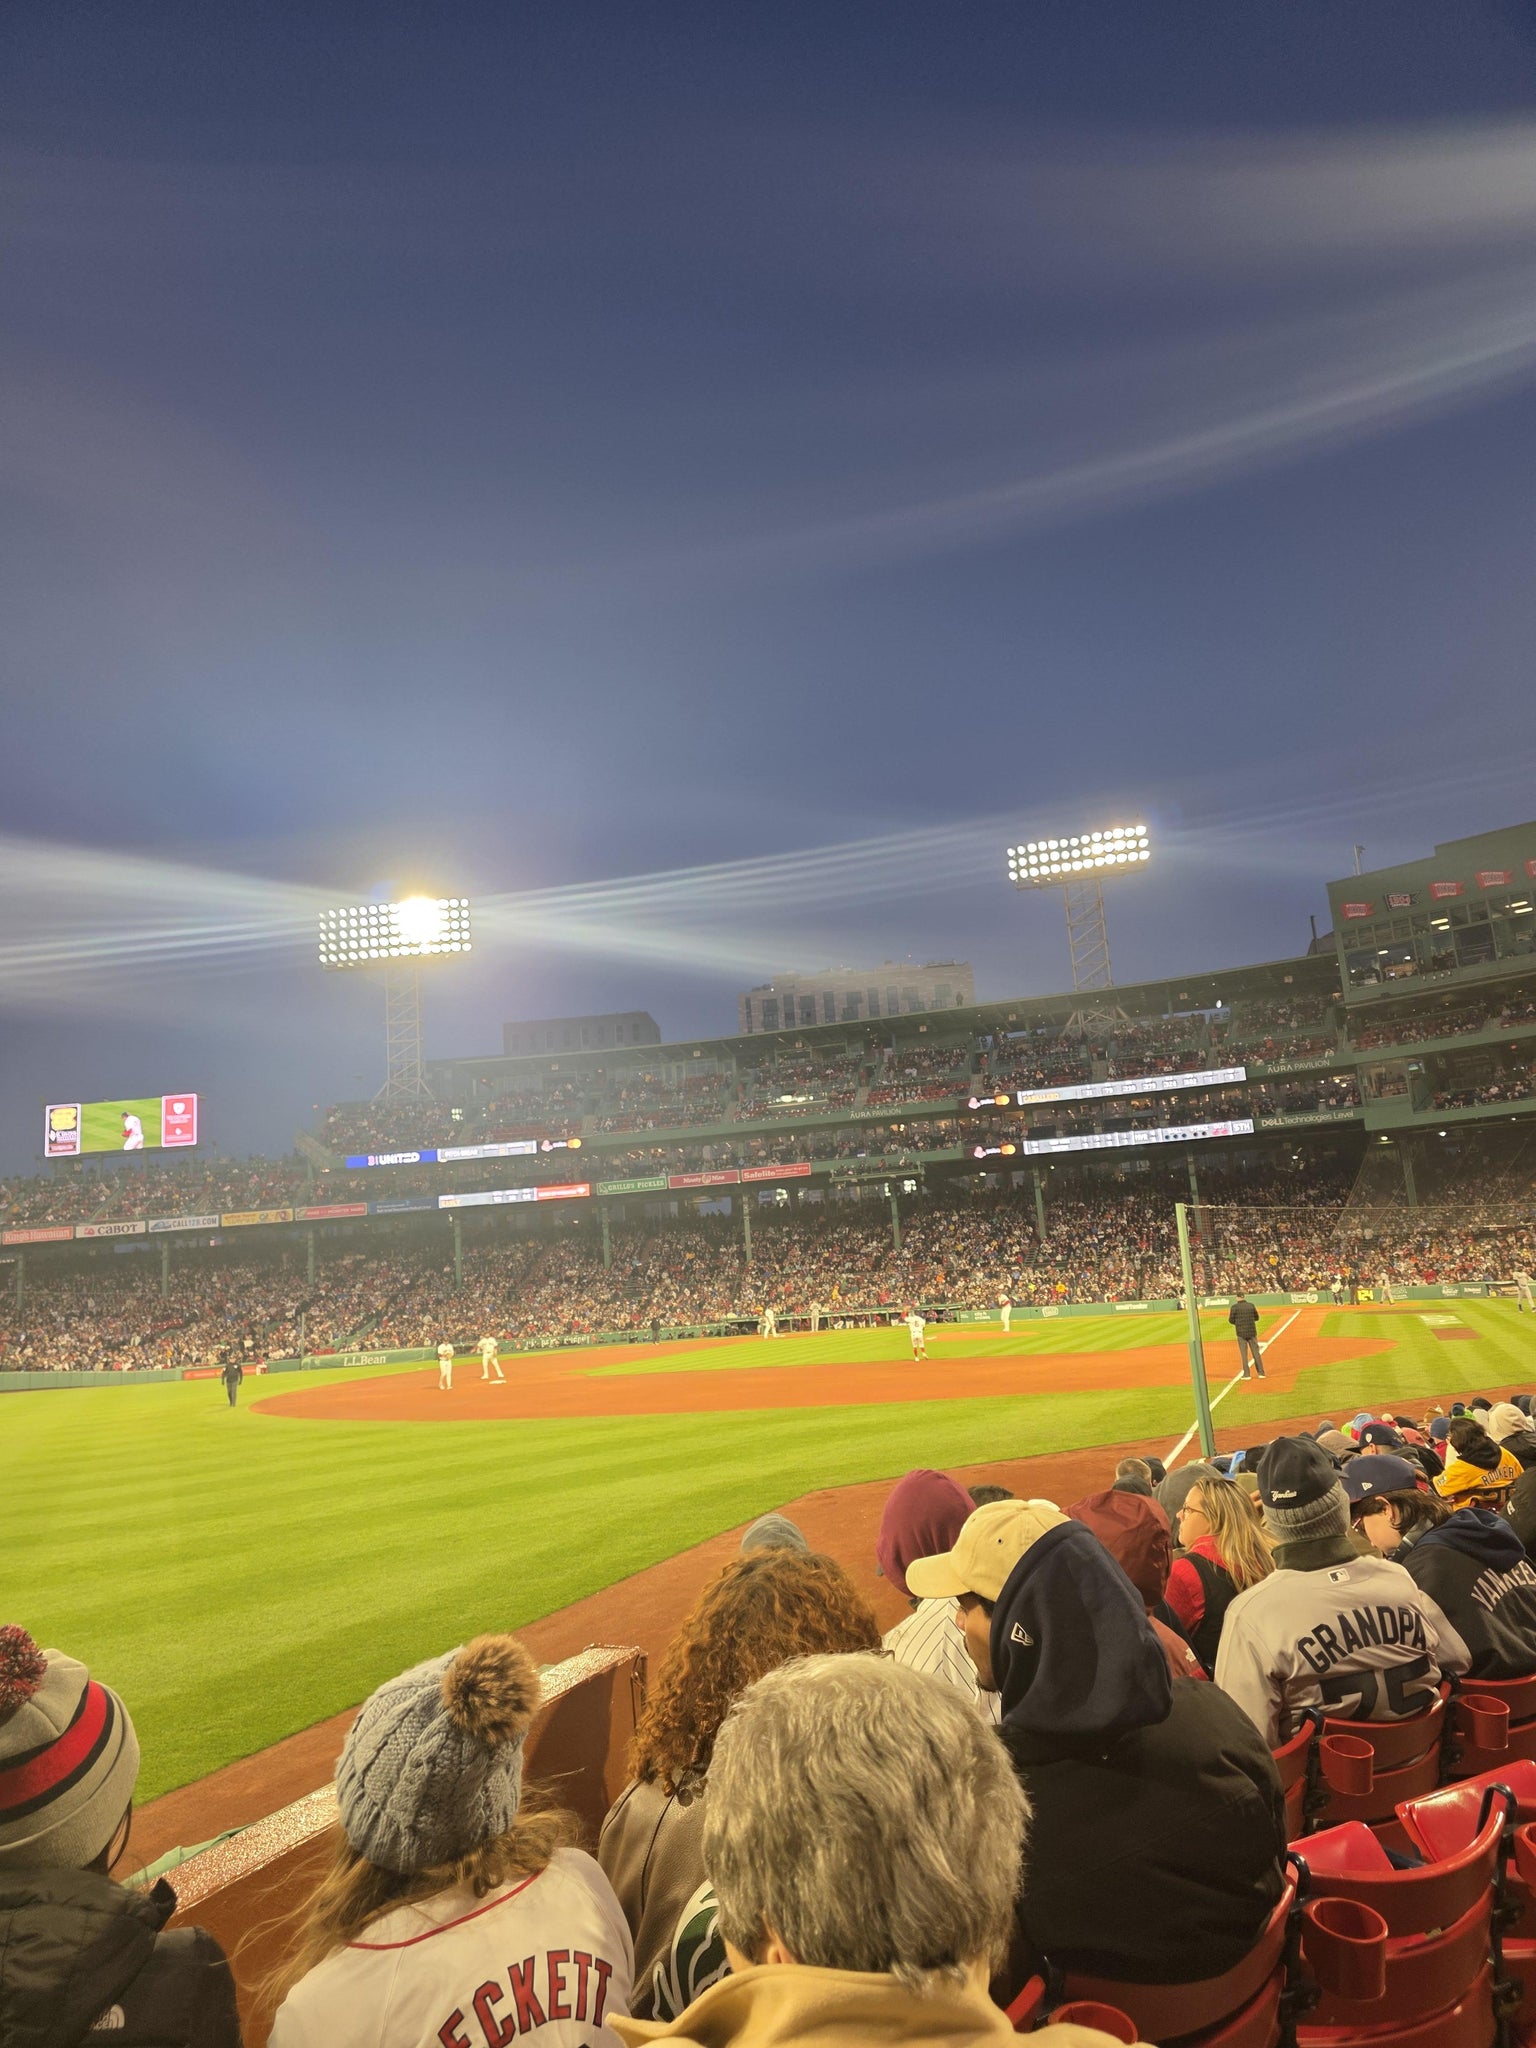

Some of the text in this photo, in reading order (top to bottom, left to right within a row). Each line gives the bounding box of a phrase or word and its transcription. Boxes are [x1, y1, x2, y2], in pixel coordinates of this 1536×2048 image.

[1294, 1060, 1330, 1070] PAVILION
[871, 1107, 902, 1117] PAVILION
[1261, 1111, 1354, 1127] DELL Technologies Level
[379, 1152, 420, 1165] UNITED
[744, 1170, 776, 1179] Safelite
[343, 1354, 387, 1367] L.L.Bean
[1297, 1605, 1427, 1674] GRANDPA
[1319, 1653, 1435, 1721] 75
